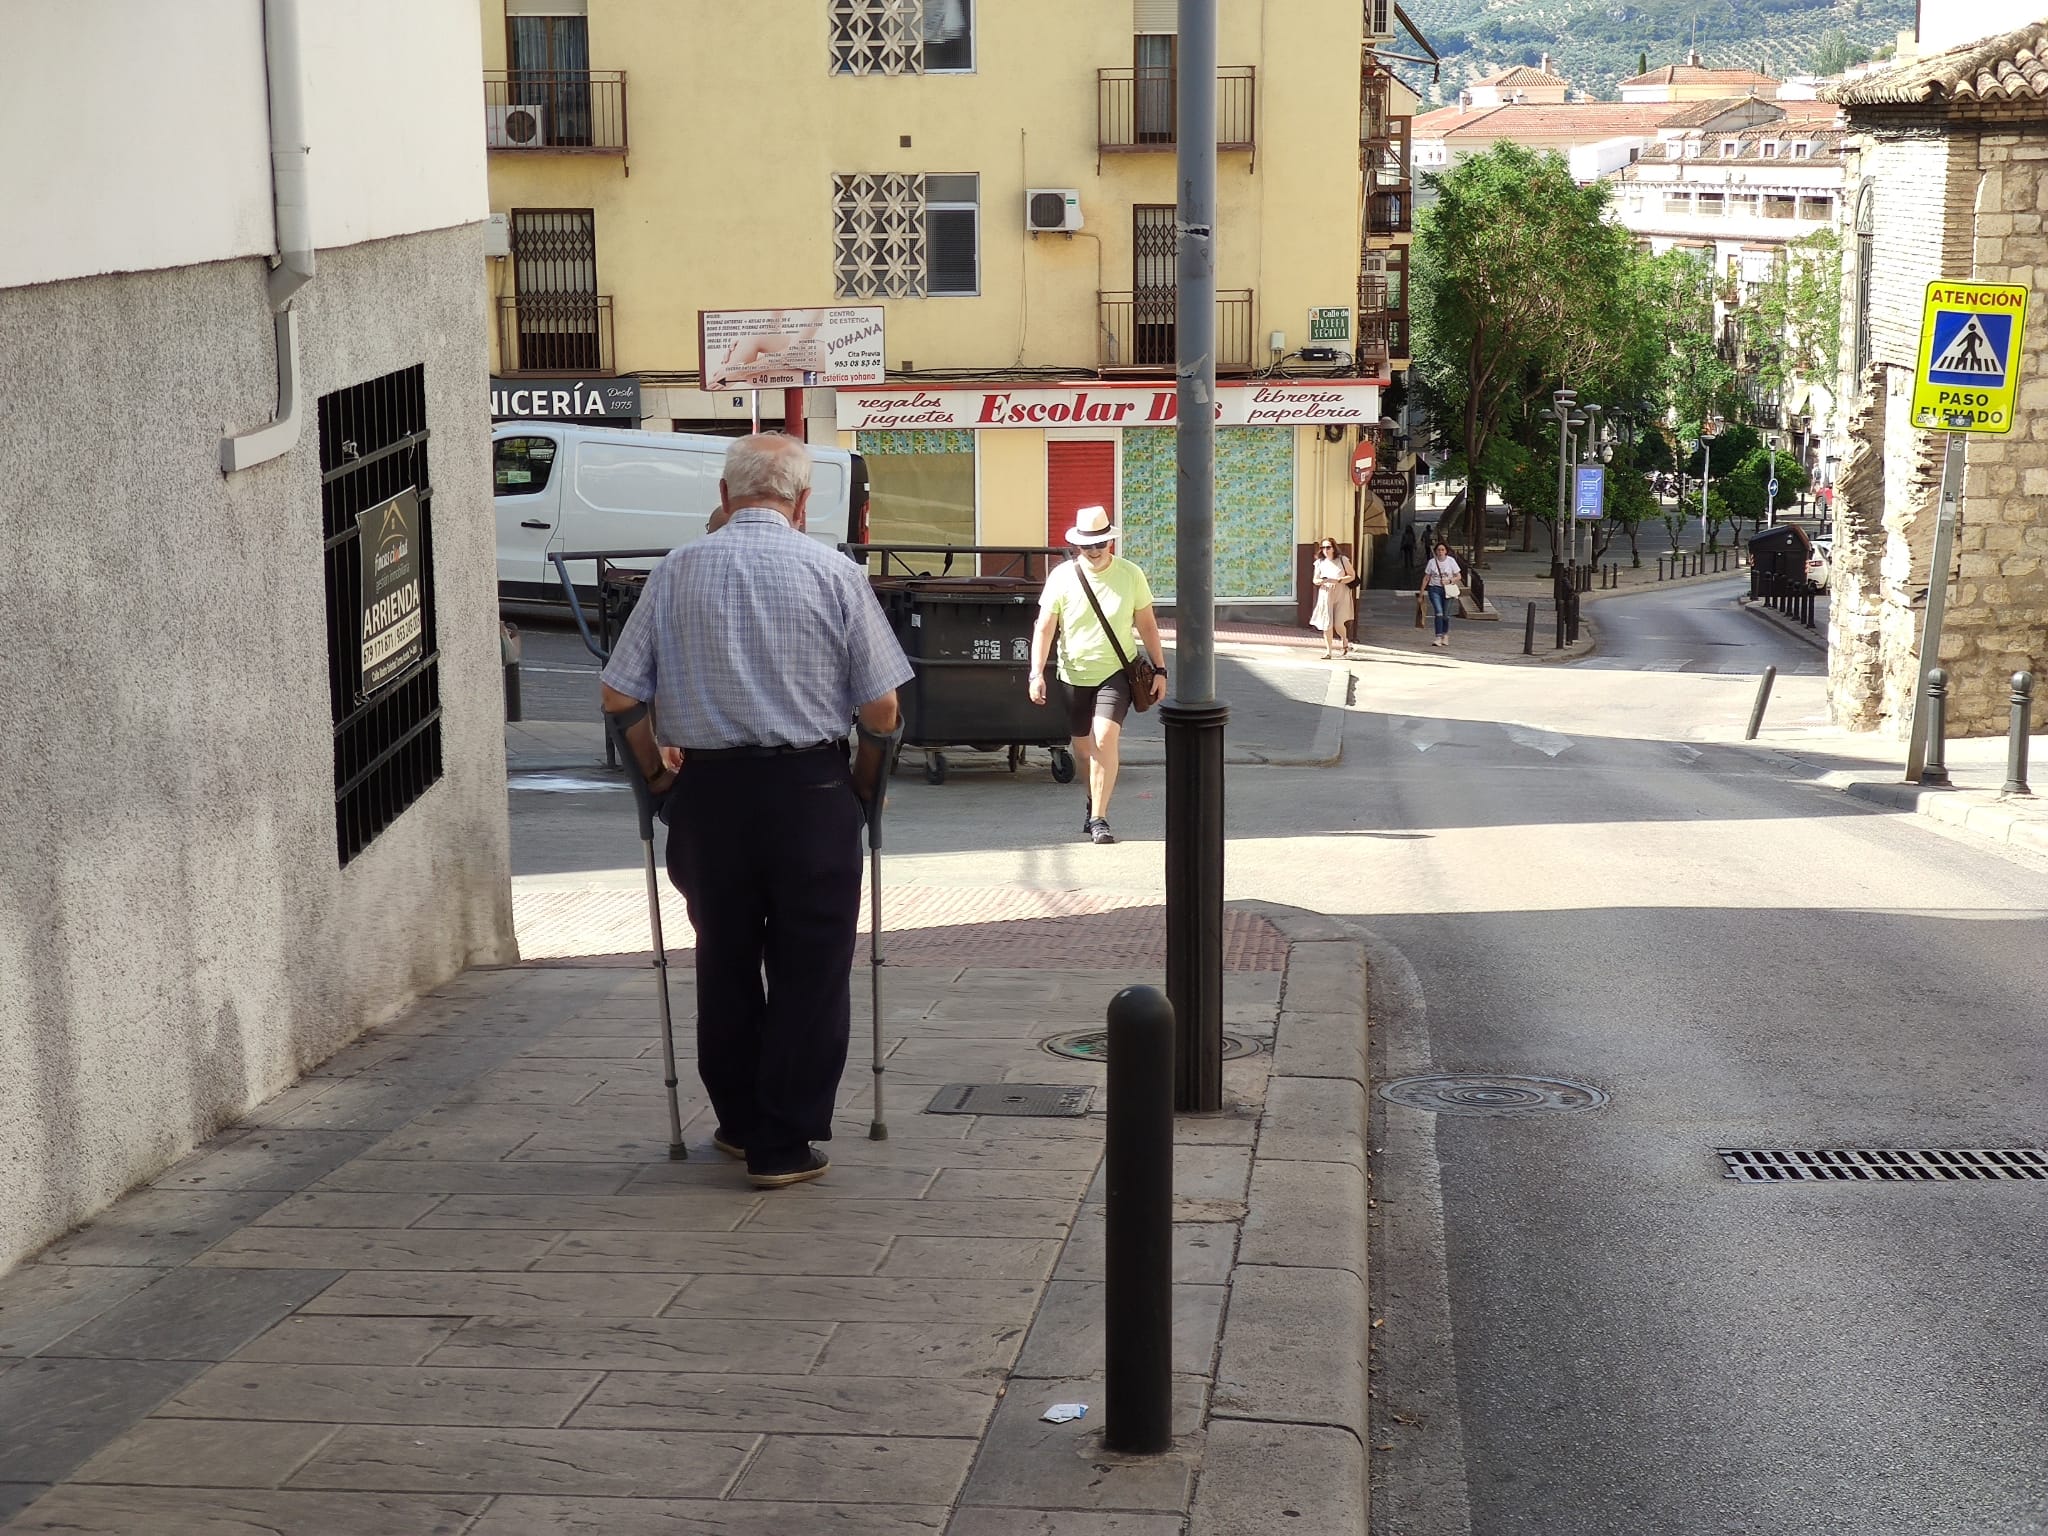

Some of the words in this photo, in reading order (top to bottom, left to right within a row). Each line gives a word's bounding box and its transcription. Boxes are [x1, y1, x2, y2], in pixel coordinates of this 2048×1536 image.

[1932, 290, 2022, 307] ATENCIÓN
[827, 323, 882, 355] YOHANA
[759, 374, 768, 383] 40
[770, 373, 794, 383] metros
[850, 373, 876, 382] yohana
[607, 386, 634, 397] Desde
[1939, 391, 1989, 407] PASO
[610, 400, 632, 410] 1975
[858, 392, 942, 412] regalos
[976, 393, 1135, 424] Escolar
[852, 411, 954, 428] juguetes
[364, 578, 420, 640] ARRIENDA
